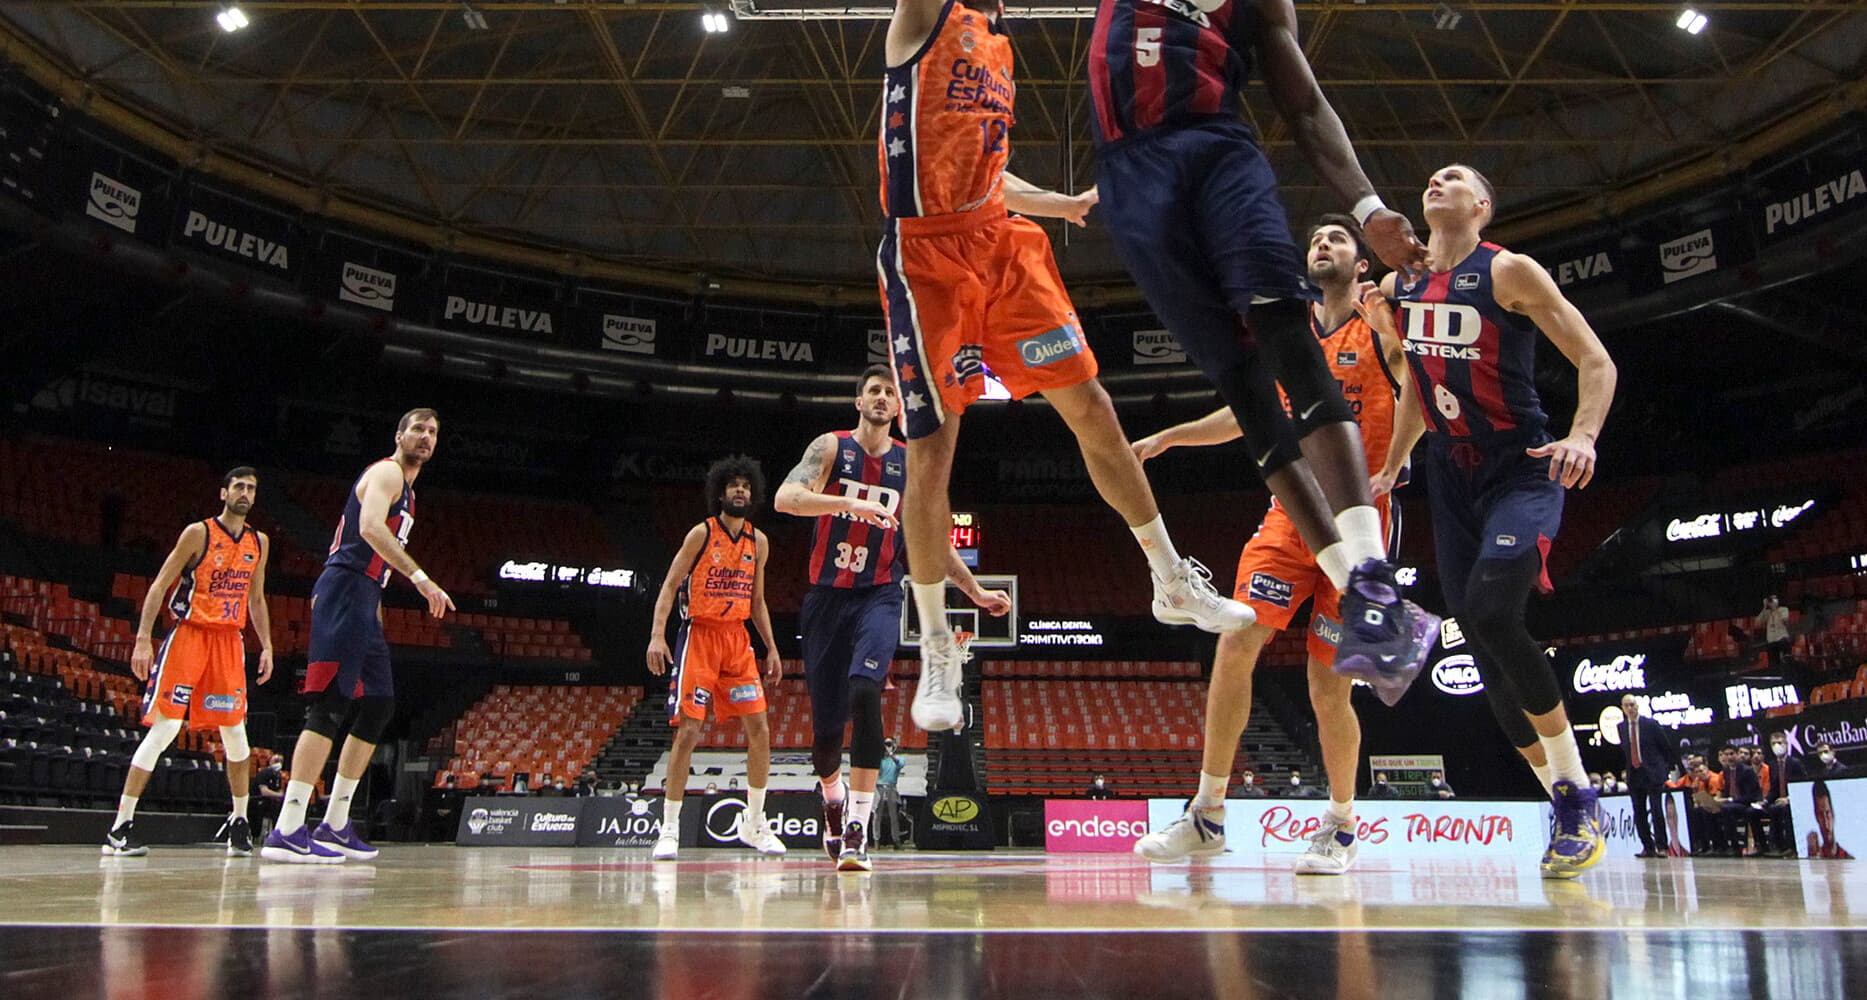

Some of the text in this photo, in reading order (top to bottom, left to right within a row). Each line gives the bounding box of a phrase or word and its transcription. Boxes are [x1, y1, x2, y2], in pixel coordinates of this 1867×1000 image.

[1135, 27, 1162, 68] 5
[951, 58, 1010, 101] Cultura
[979, 119, 1008, 155] 12
[95, 178, 138, 208] PULEVA
[1766, 170, 1867, 234] PULEVA
[184, 210, 288, 269] PULEVA
[1663, 236, 1709, 259] PULEVA
[346, 267, 393, 290] PULEVA
[444, 296, 553, 334] PULEVA
[606, 319, 654, 334] PULEVA
[1401, 301, 1482, 345] TD
[706, 334, 814, 362] PULEVA
[1402, 339, 1481, 360] SYSTEMS
[834, 541, 868, 573] 33
[211, 568, 250, 581] Cultura
[708, 566, 746, 578] Cultura
[221, 601, 240, 620] 30
[720, 601, 734, 617] 7
[1062, 621, 1093, 630] DENTAL
[490, 808, 518, 818] valencia
[533, 812, 568, 824] Cultura
[938, 799, 971, 818] AP
[531, 822, 575, 832] Esfuerzo
[1048, 815, 1148, 839] endesa
[1402, 813, 1514, 846] TARONJA
